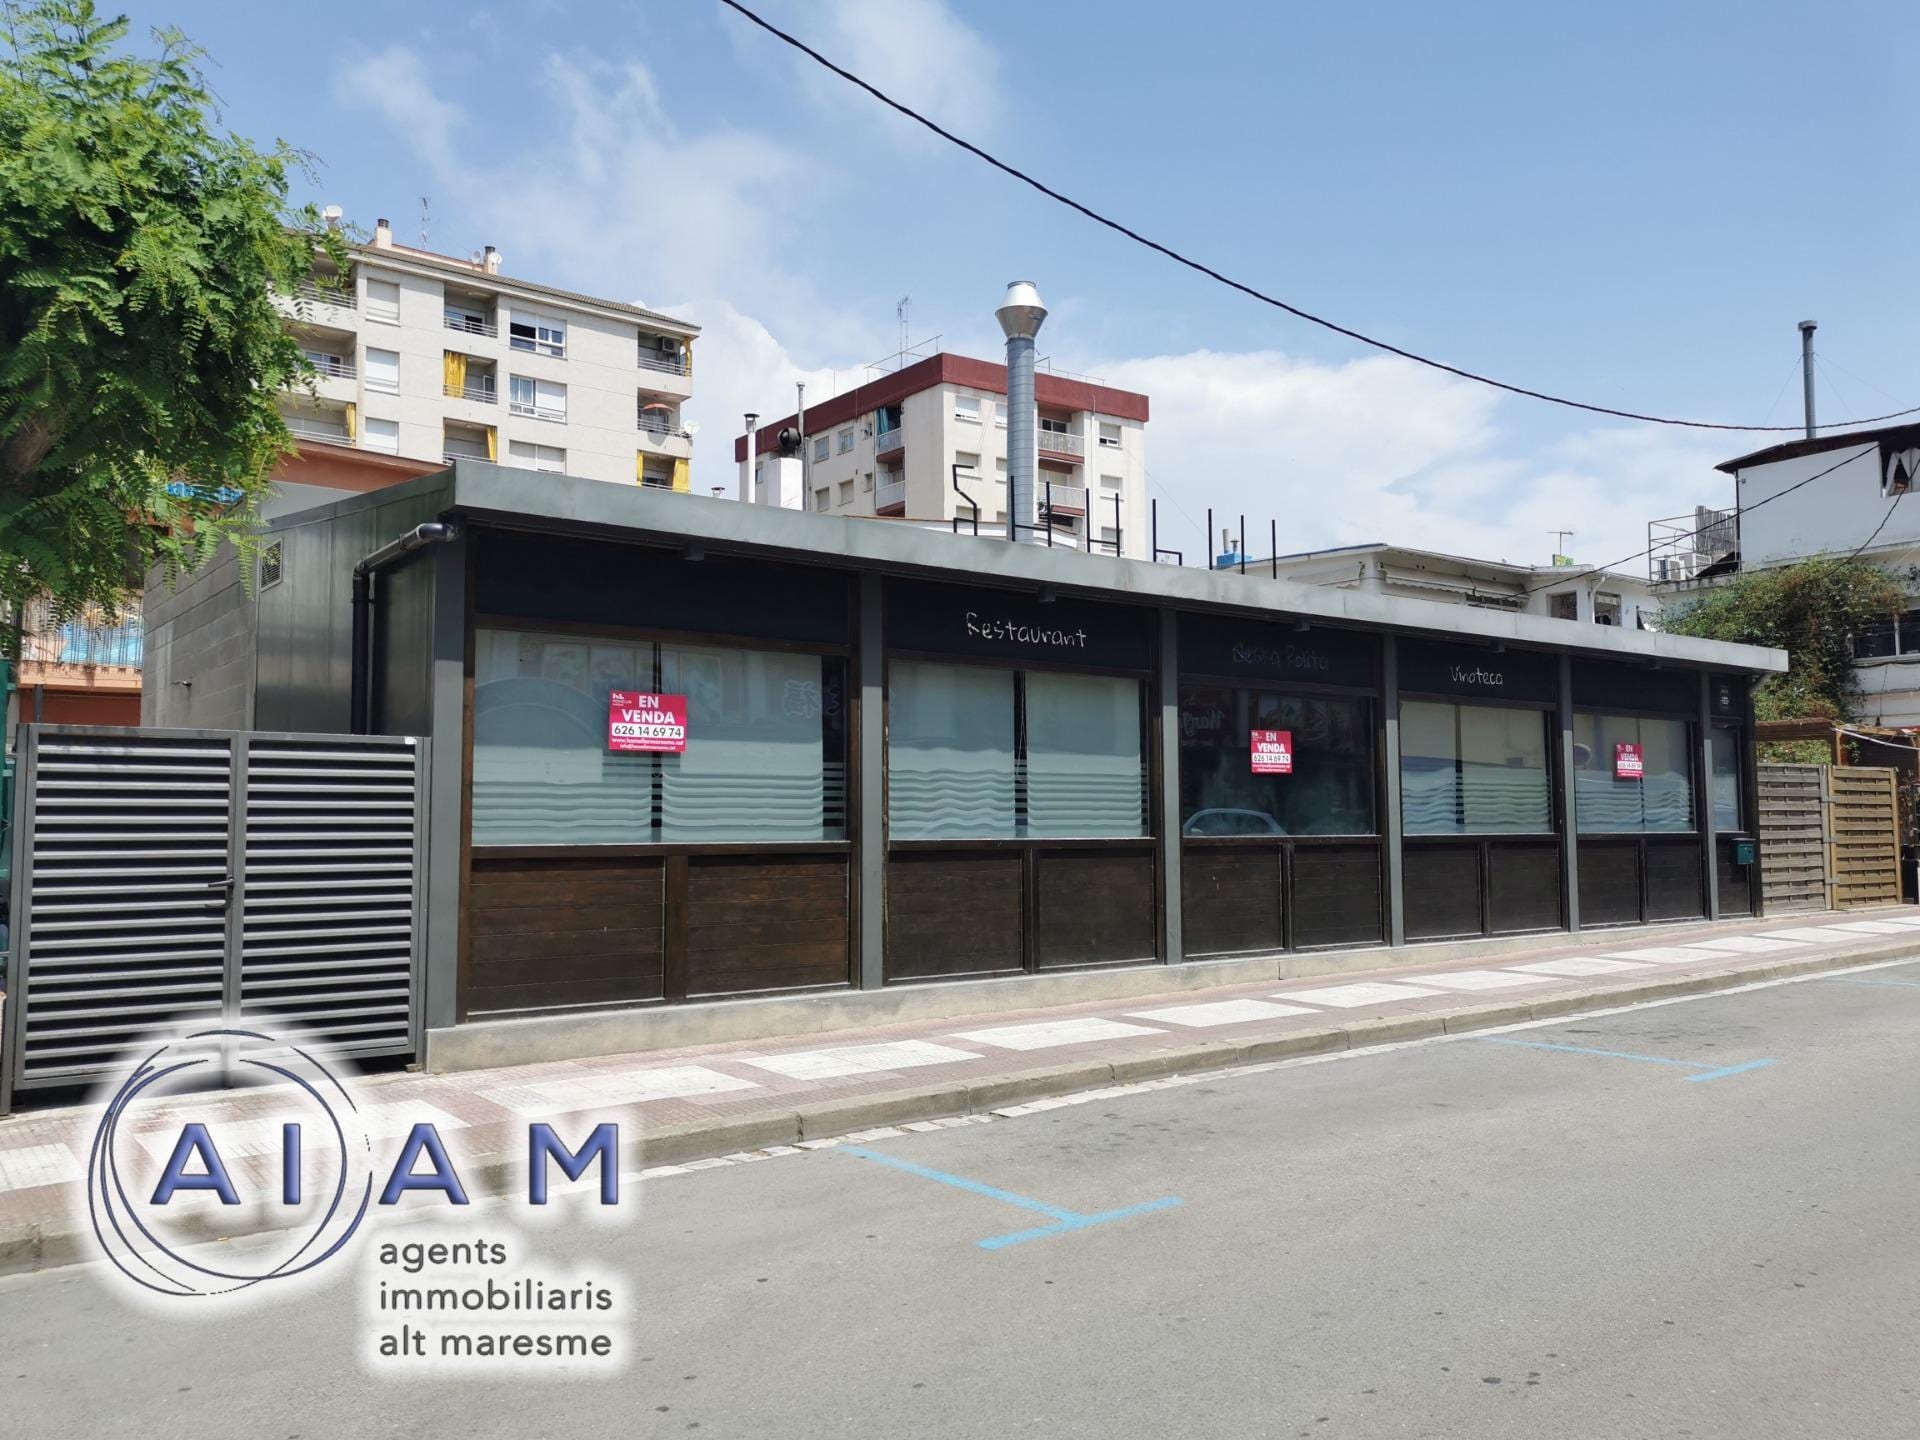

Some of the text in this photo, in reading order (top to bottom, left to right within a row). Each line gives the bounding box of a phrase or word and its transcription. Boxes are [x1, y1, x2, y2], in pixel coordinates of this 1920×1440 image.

[966, 611, 1087, 648] Restaurant
[1450, 665, 1504, 686] Vinoteca
[639, 695, 659, 709] EN
[622, 709, 676, 724] VENDA
[614, 725, 682, 738] 626 14 69 74
[1266, 732, 1276, 742] EN
[1256, 742, 1286, 753] VENDA
